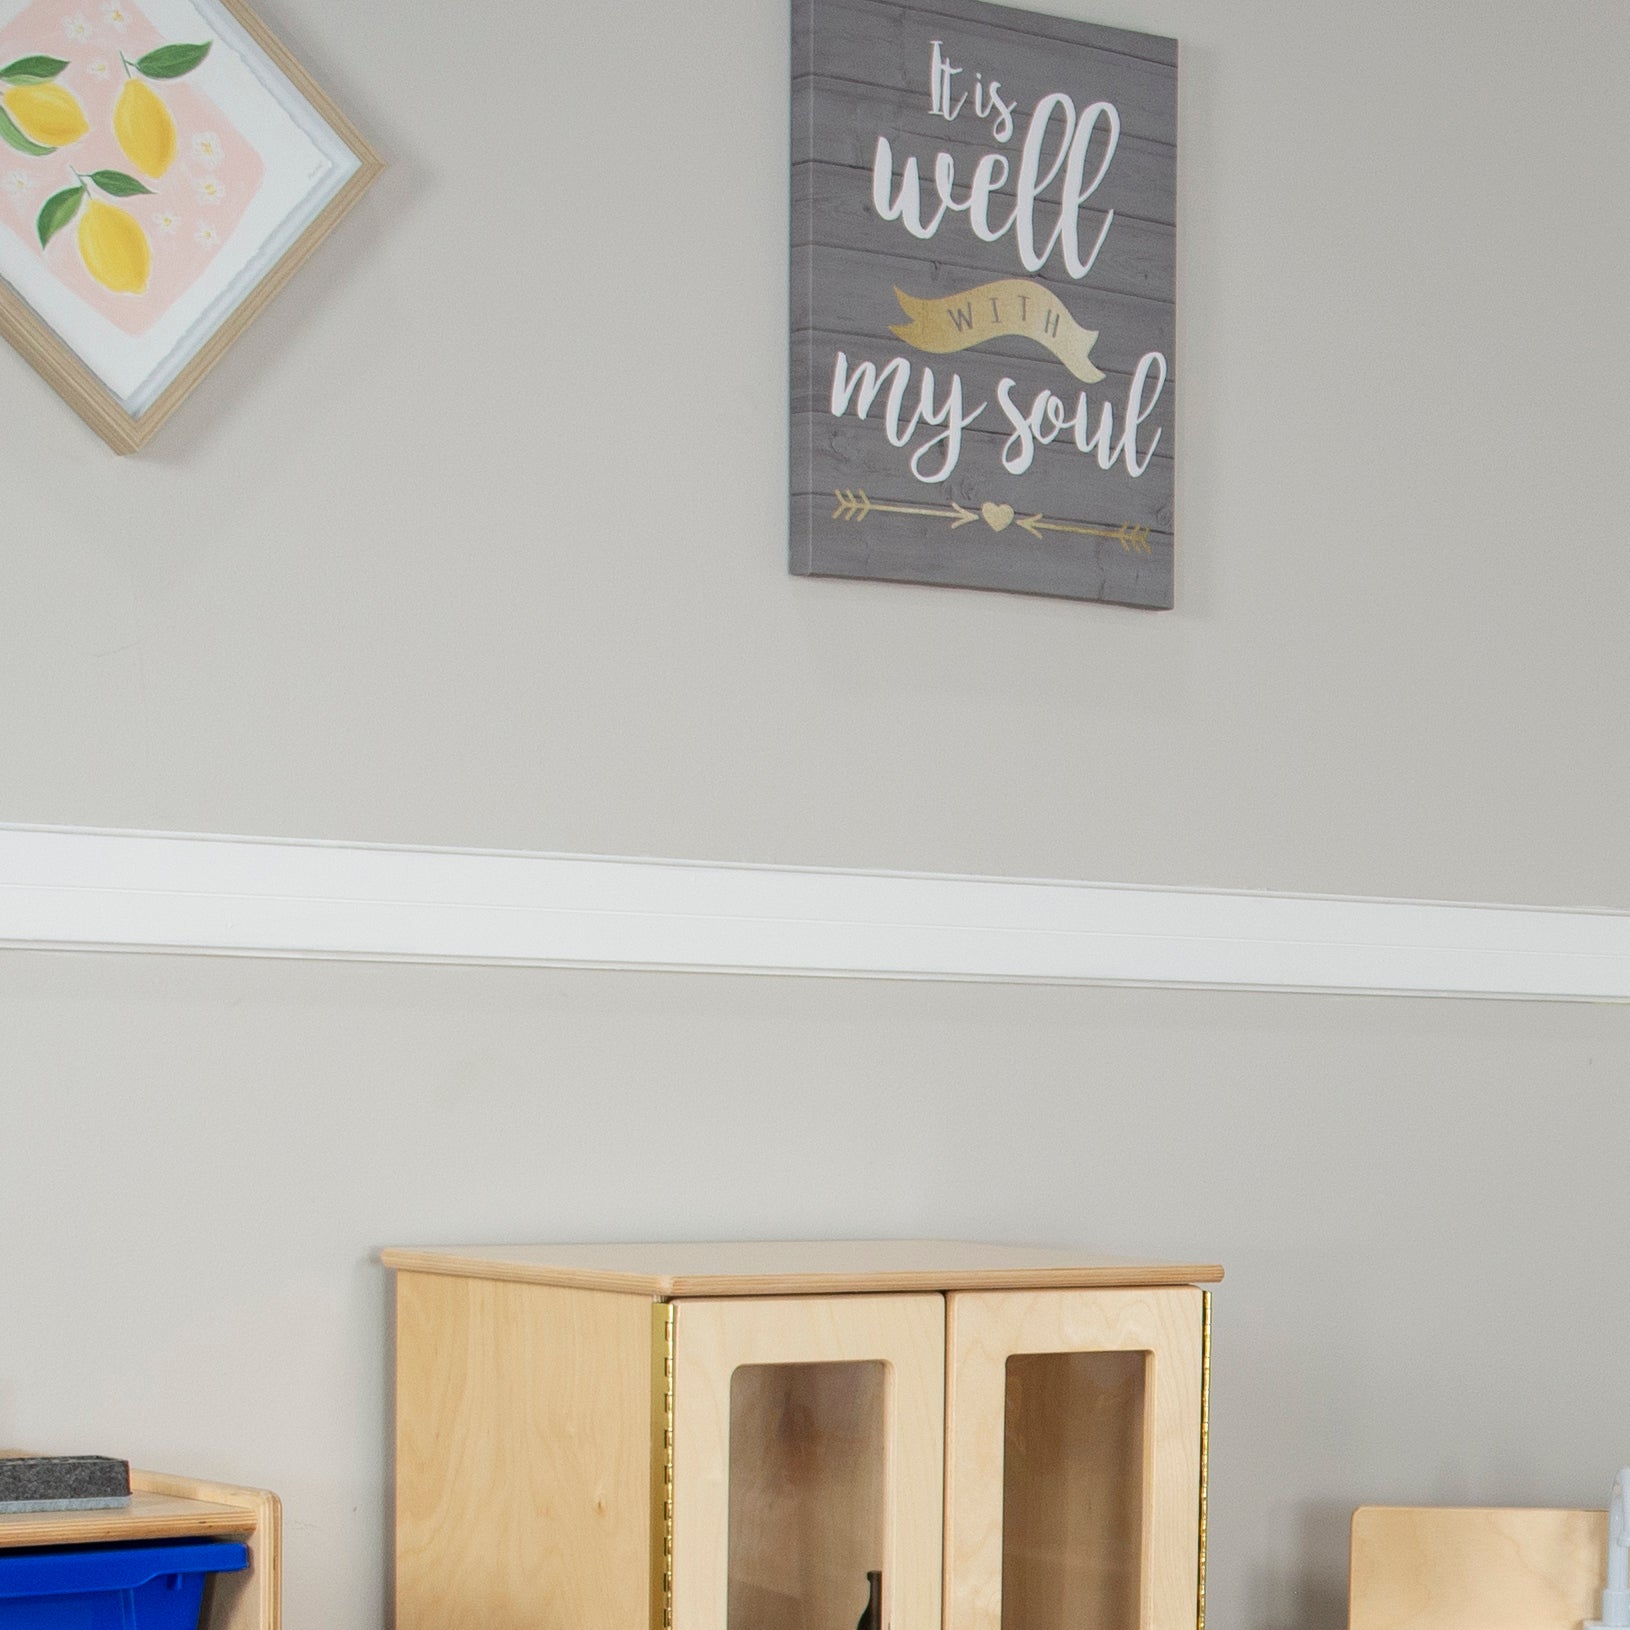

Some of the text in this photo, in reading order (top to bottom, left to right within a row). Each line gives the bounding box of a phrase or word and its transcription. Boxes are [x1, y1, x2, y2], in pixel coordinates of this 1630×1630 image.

[928, 41, 1018, 143] It is
[873, 93, 1121, 280] well
[948, 295, 1060, 339] WITH
[831, 351, 1167, 483] my soul
